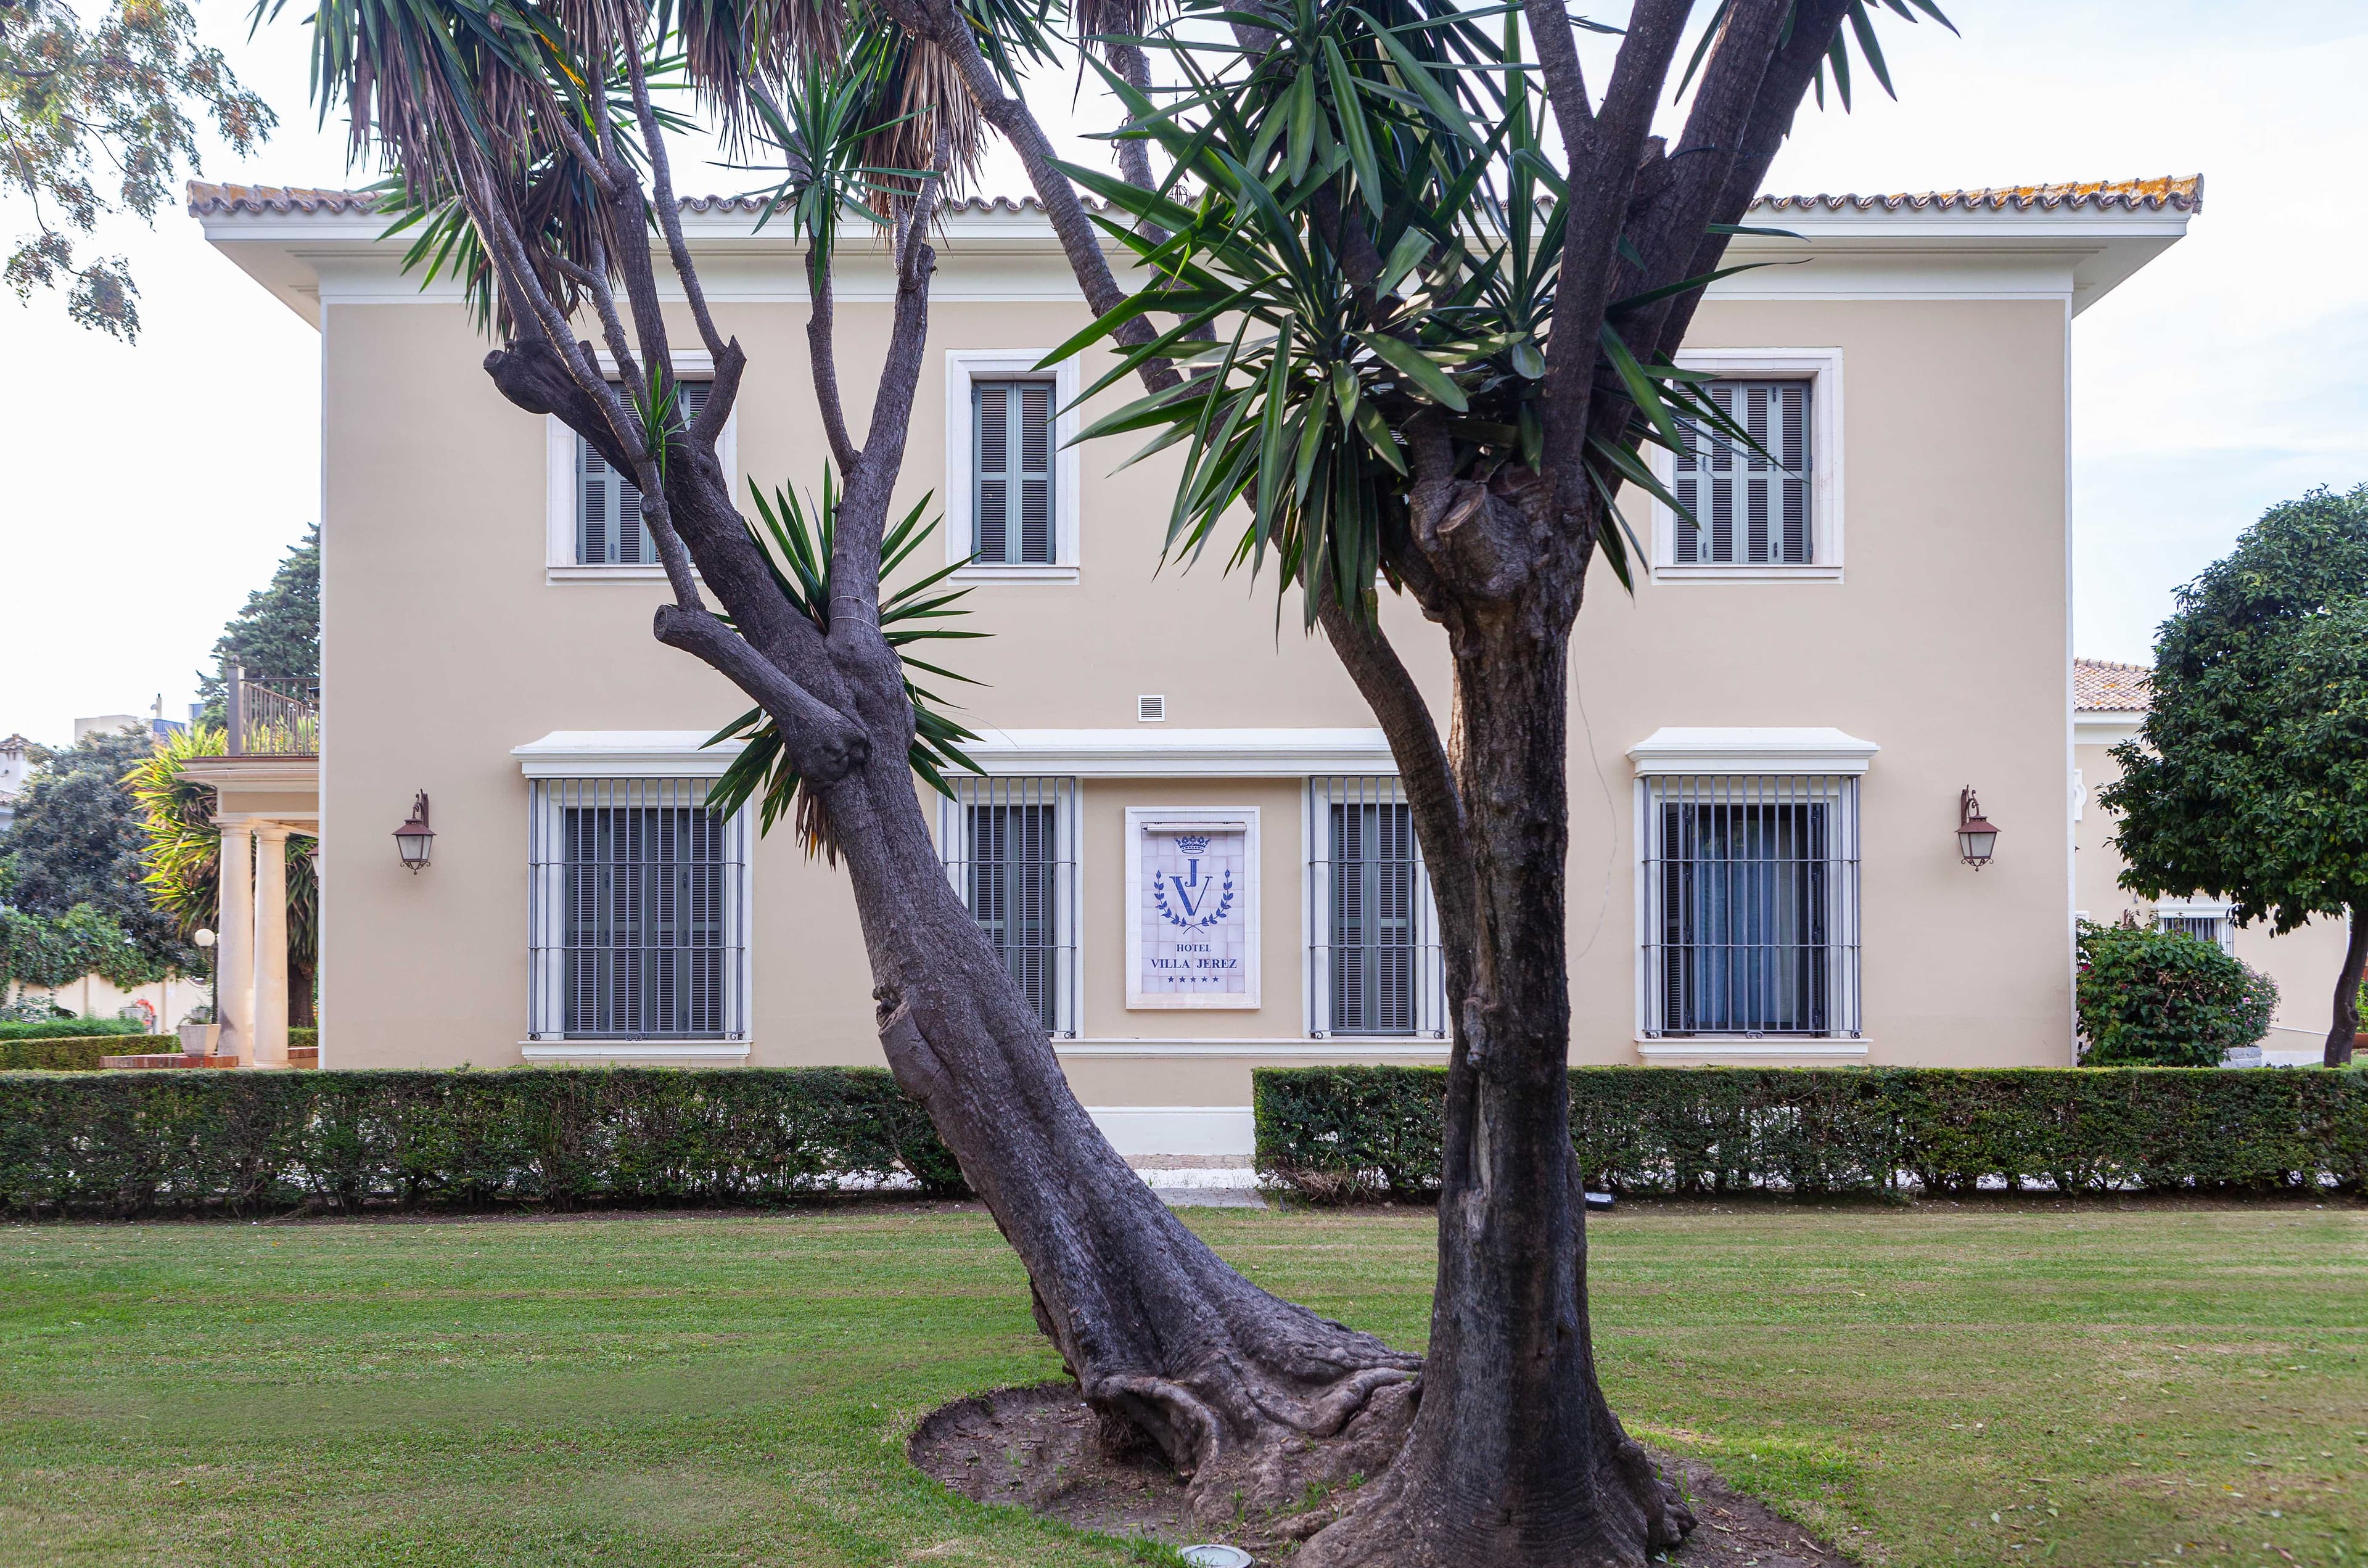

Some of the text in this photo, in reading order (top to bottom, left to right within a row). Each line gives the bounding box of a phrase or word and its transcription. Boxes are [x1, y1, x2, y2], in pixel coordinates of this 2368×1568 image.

[1177, 944, 1212, 952] HOTEL
[1151, 959, 1237, 969] VILLA JEREZ
